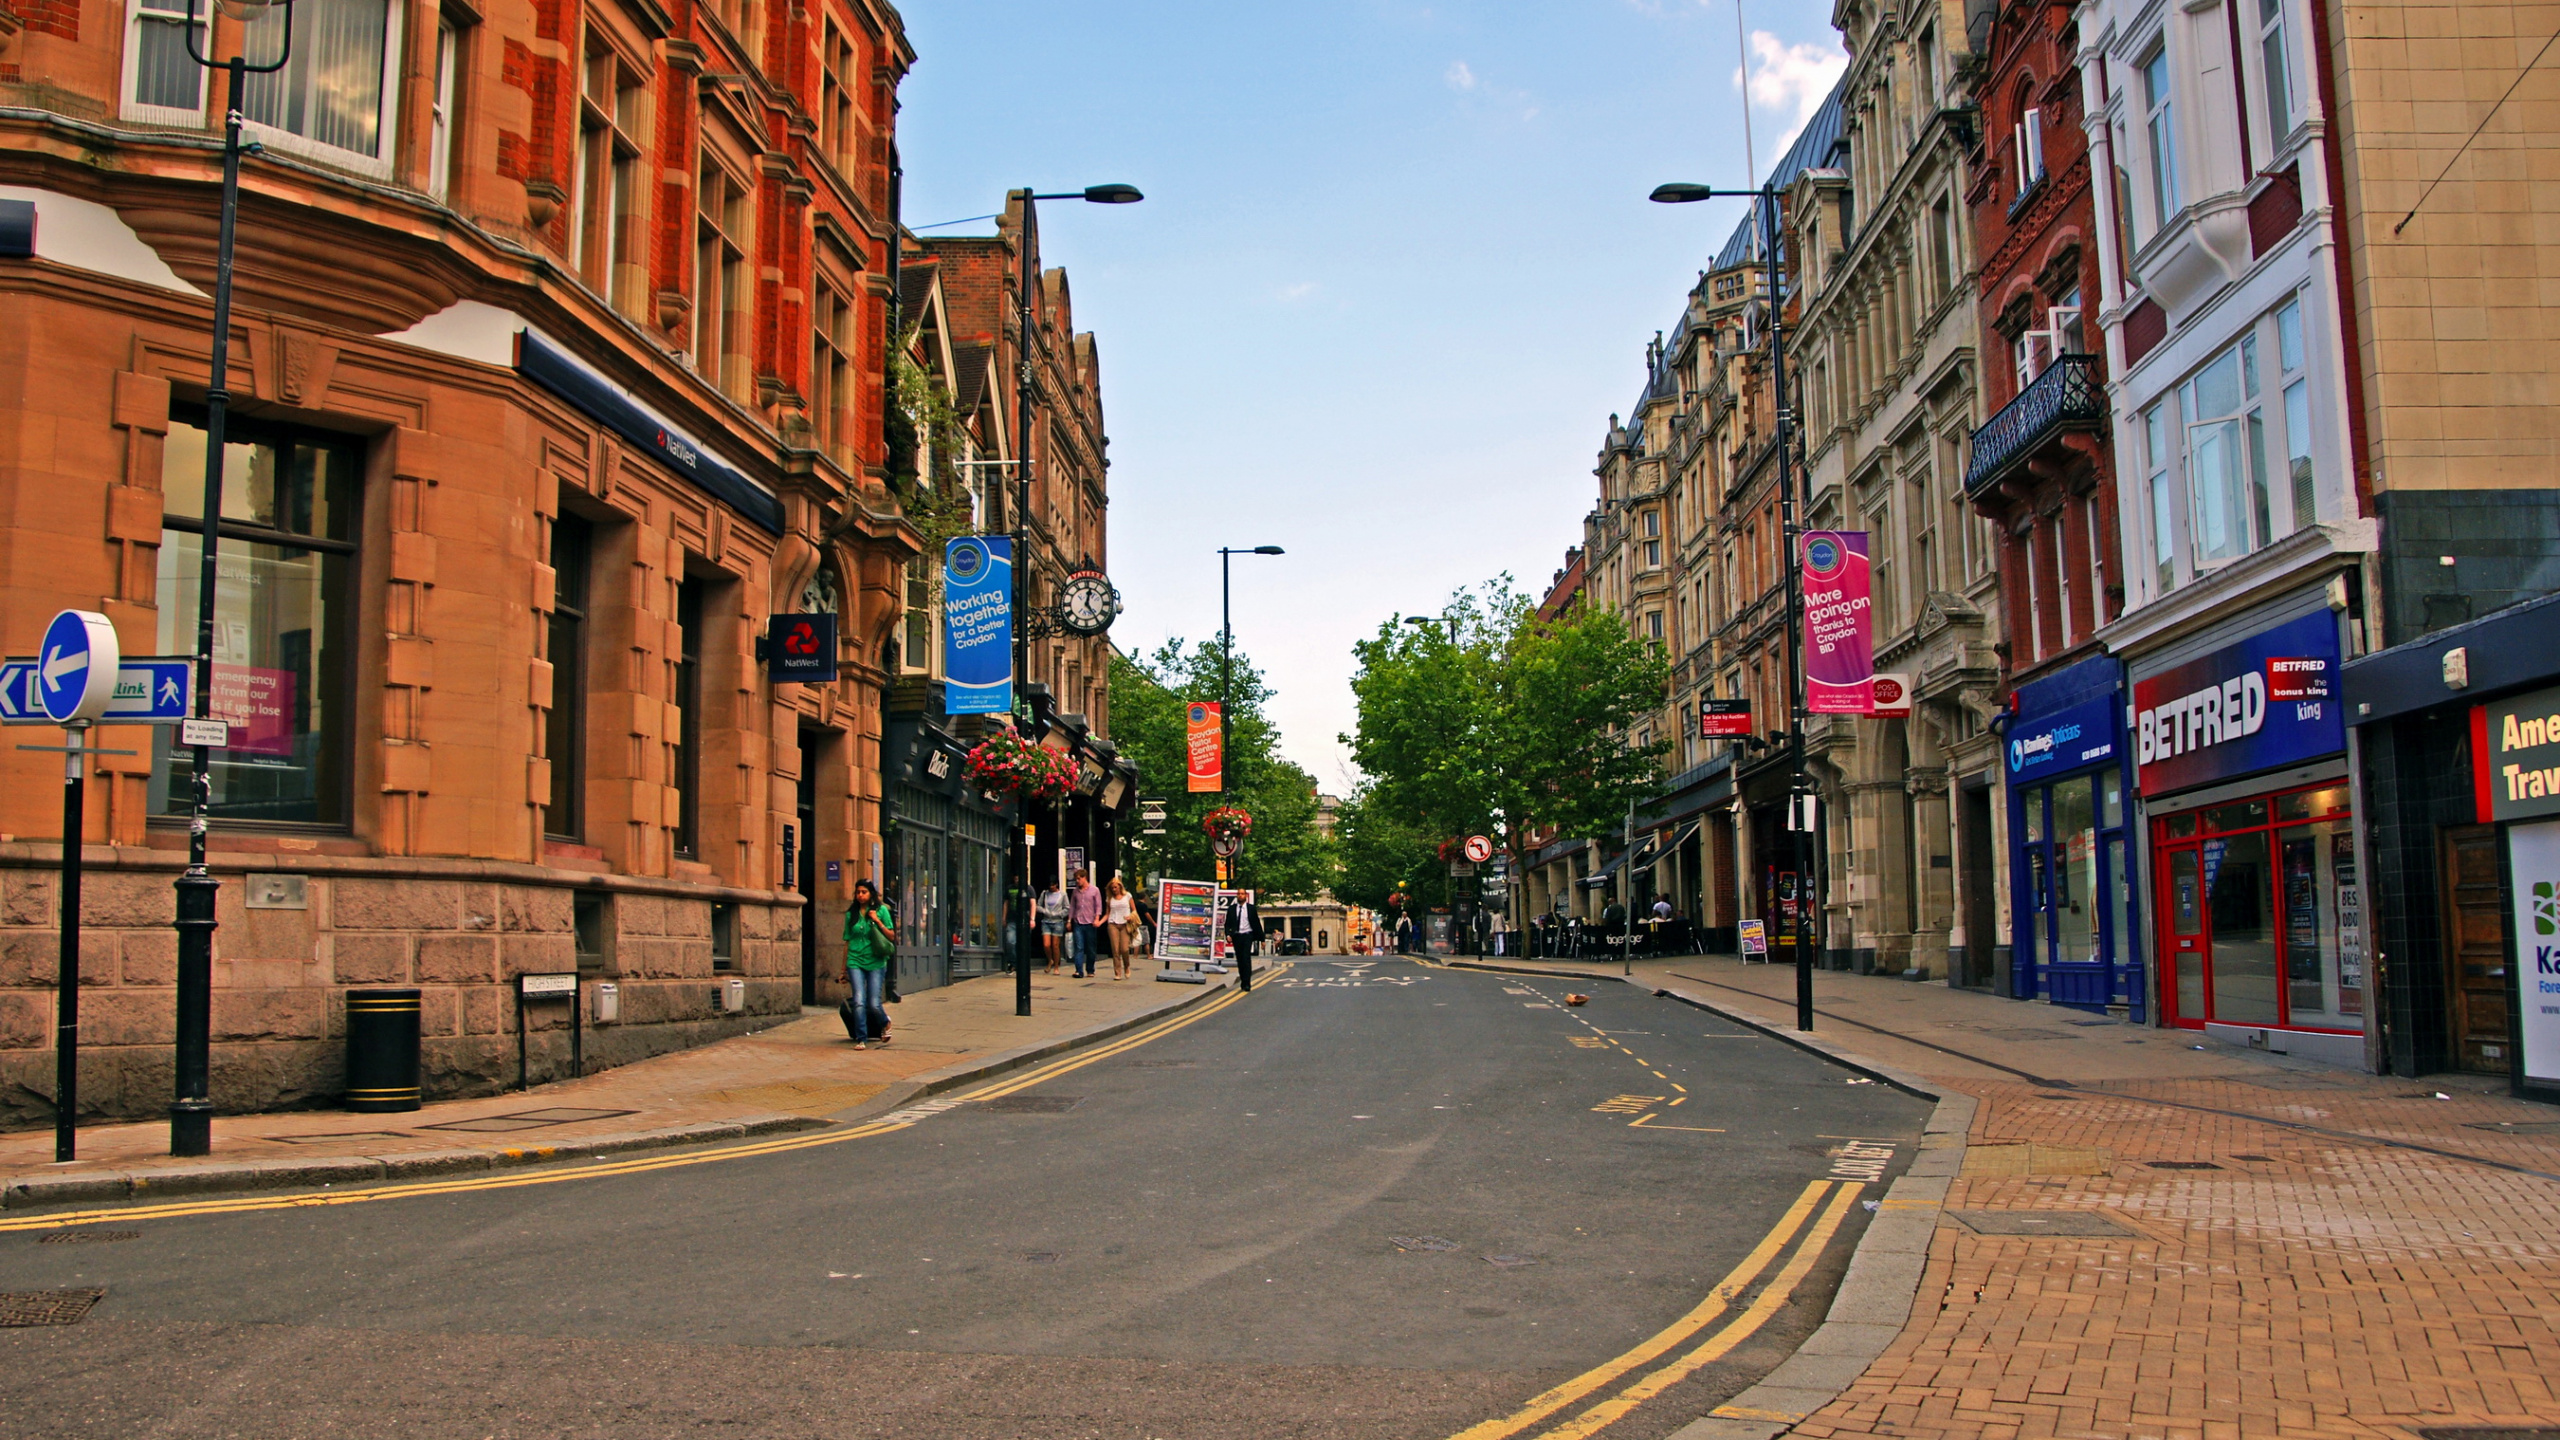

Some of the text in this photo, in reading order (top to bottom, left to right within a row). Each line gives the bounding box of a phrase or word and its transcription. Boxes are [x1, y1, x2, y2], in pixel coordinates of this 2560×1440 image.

[666, 435, 697, 469] NatWest
[946, 590, 1003, 614] Working
[1804, 589, 1842, 608] More
[950, 603, 1010, 628] together
[1809, 596, 1871, 624] going on
[953, 620, 1006, 640] for a better
[1813, 617, 1855, 634] thanks to
[956, 633, 996, 649] Croydon
[1816, 627, 1857, 644] Croydon
[1819, 642, 1835, 655] BID
[784, 659, 819, 667] NatWest
[2272, 660, 2325, 672] BETFRED
[215, 672, 276, 688] emergency
[2314, 678, 2327, 686] the
[220, 684, 247, 697] from
[250, 690, 269, 699] our
[1873, 690, 1899, 698] OFFICE
[2274, 687, 2328, 696] bonus king
[224, 701, 233, 710] if
[235, 704, 256, 715] you
[259, 703, 280, 716] lose
[2297, 701, 2321, 721] king
[2139, 670, 2266, 766] BETFRED
[1187, 727, 1221, 740] Croydon
[1188, 738, 1212, 748] Visitor
[1191, 744, 1218, 755] Centre
[170, 750, 195, 759] NatWe
[2503, 764, 2560, 801] Trav
[546, 976, 567, 988] STREET
